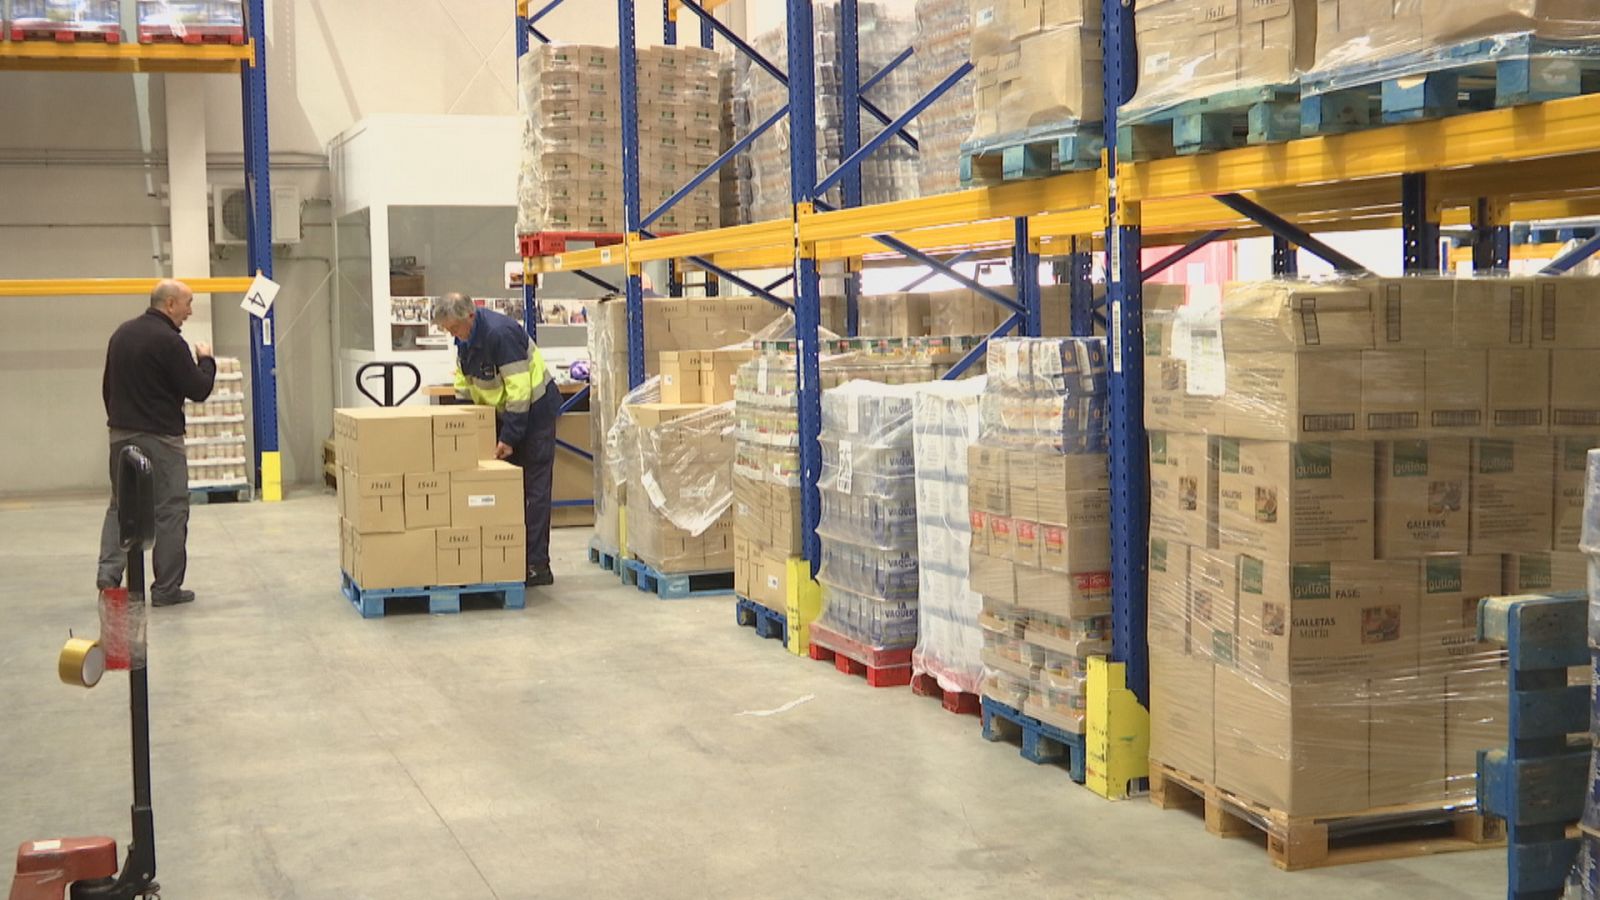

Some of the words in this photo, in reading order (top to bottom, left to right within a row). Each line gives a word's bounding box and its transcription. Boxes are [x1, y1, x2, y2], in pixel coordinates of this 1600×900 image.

[248, 292, 266, 309] 4
[897, 600, 907, 609] LA
[1292, 616, 1336, 628] GALLETAS
